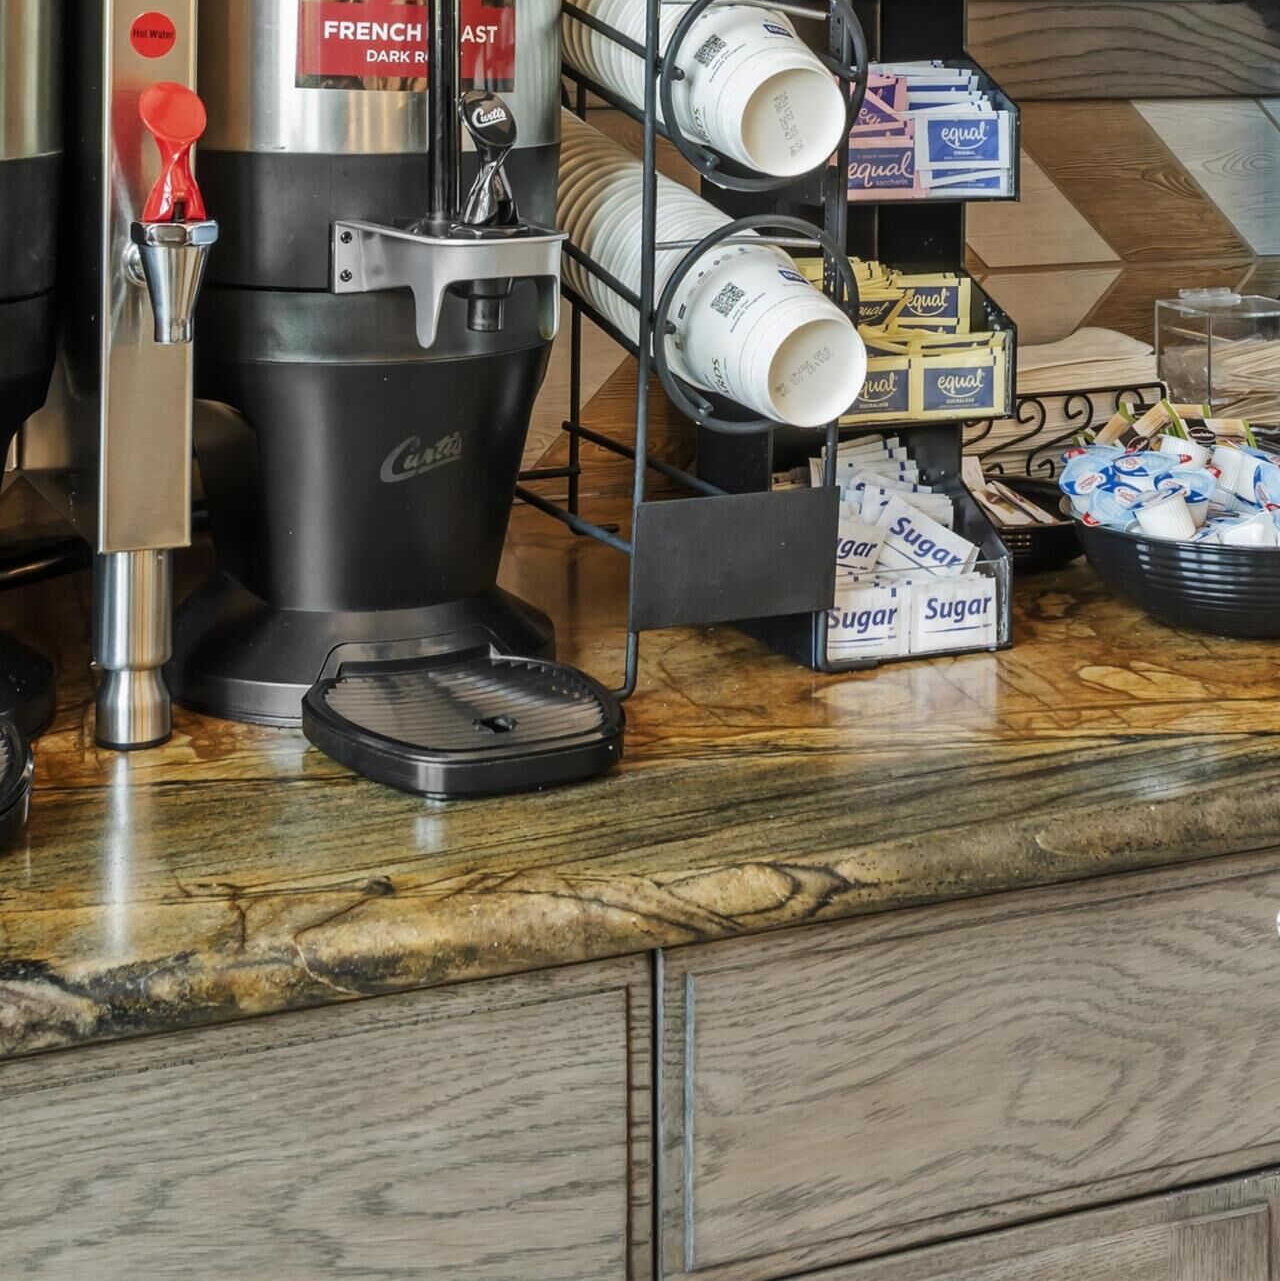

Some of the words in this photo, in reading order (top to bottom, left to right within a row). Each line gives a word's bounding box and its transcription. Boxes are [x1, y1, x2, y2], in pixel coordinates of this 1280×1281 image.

[132, 29, 148, 39] Hot
[149, 29, 174, 39] Water
[324, 21, 422, 42] FRENCH
[366, 50, 410, 63] DARK
[472, 107, 508, 128] Curtis
[941, 121, 987, 146] equal
[848, 151, 914, 188] equal
[859, 302, 889, 317] qual
[906, 288, 949, 313] equal
[860, 372, 898, 399] qual
[937, 368, 985, 394] equal
[380, 432, 463, 483] Curtis
[837, 538, 878, 559] gar
[889, 517, 963, 569] Sugar
[827, 606, 898, 634] Sugar
[925, 595, 993, 624] Sugar
